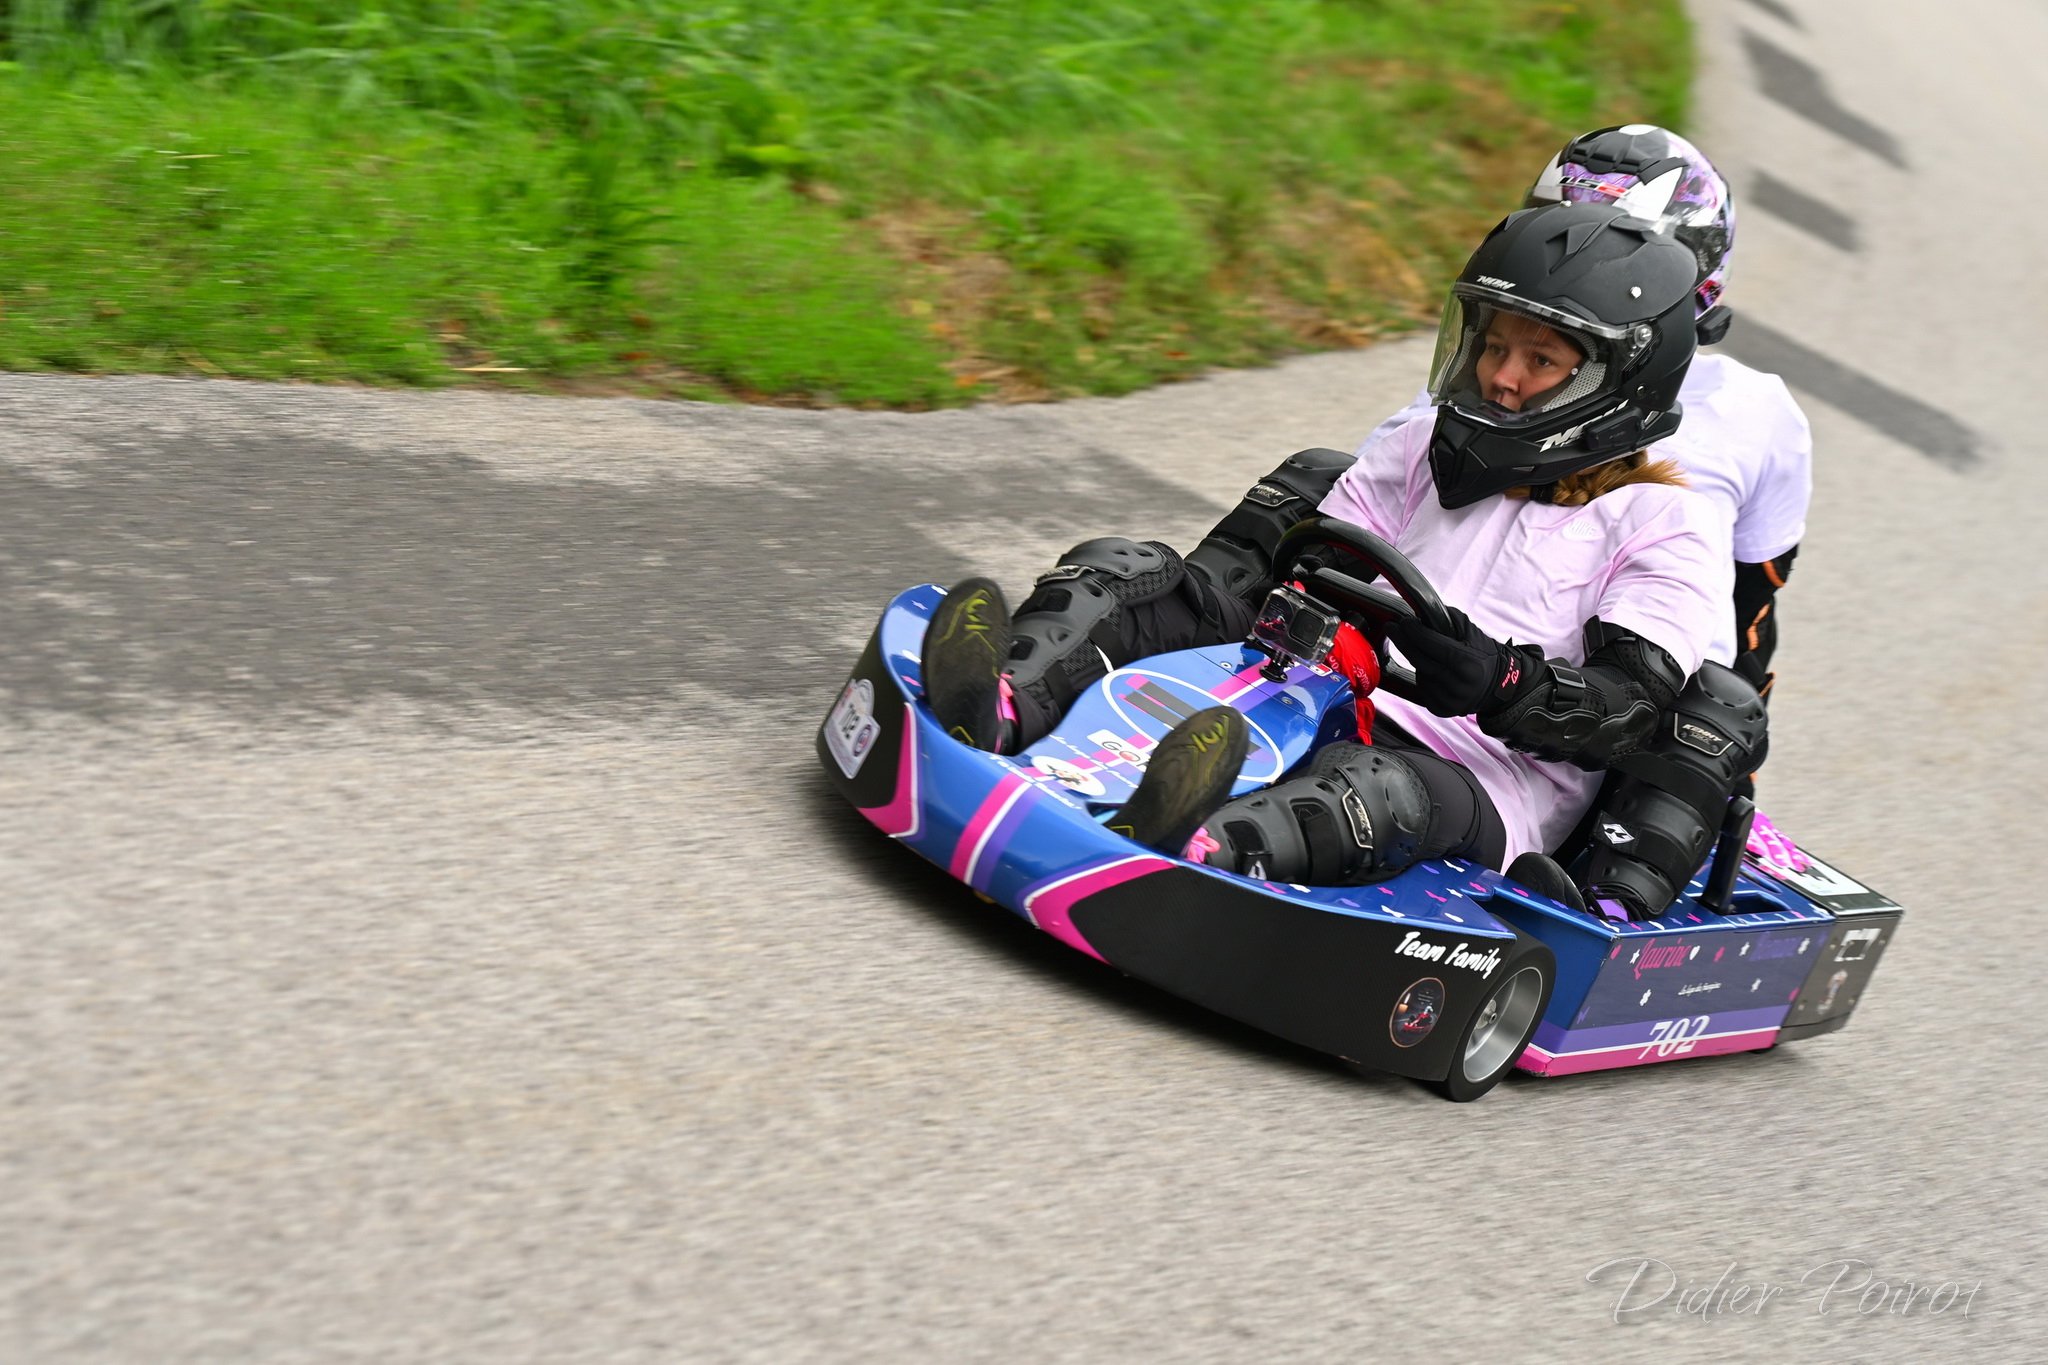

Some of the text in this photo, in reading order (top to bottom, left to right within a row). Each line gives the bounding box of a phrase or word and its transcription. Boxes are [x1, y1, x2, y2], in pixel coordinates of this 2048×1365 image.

[1394, 931, 1502, 980] Team Family
[1637, 1014, 1711, 1061] 702
